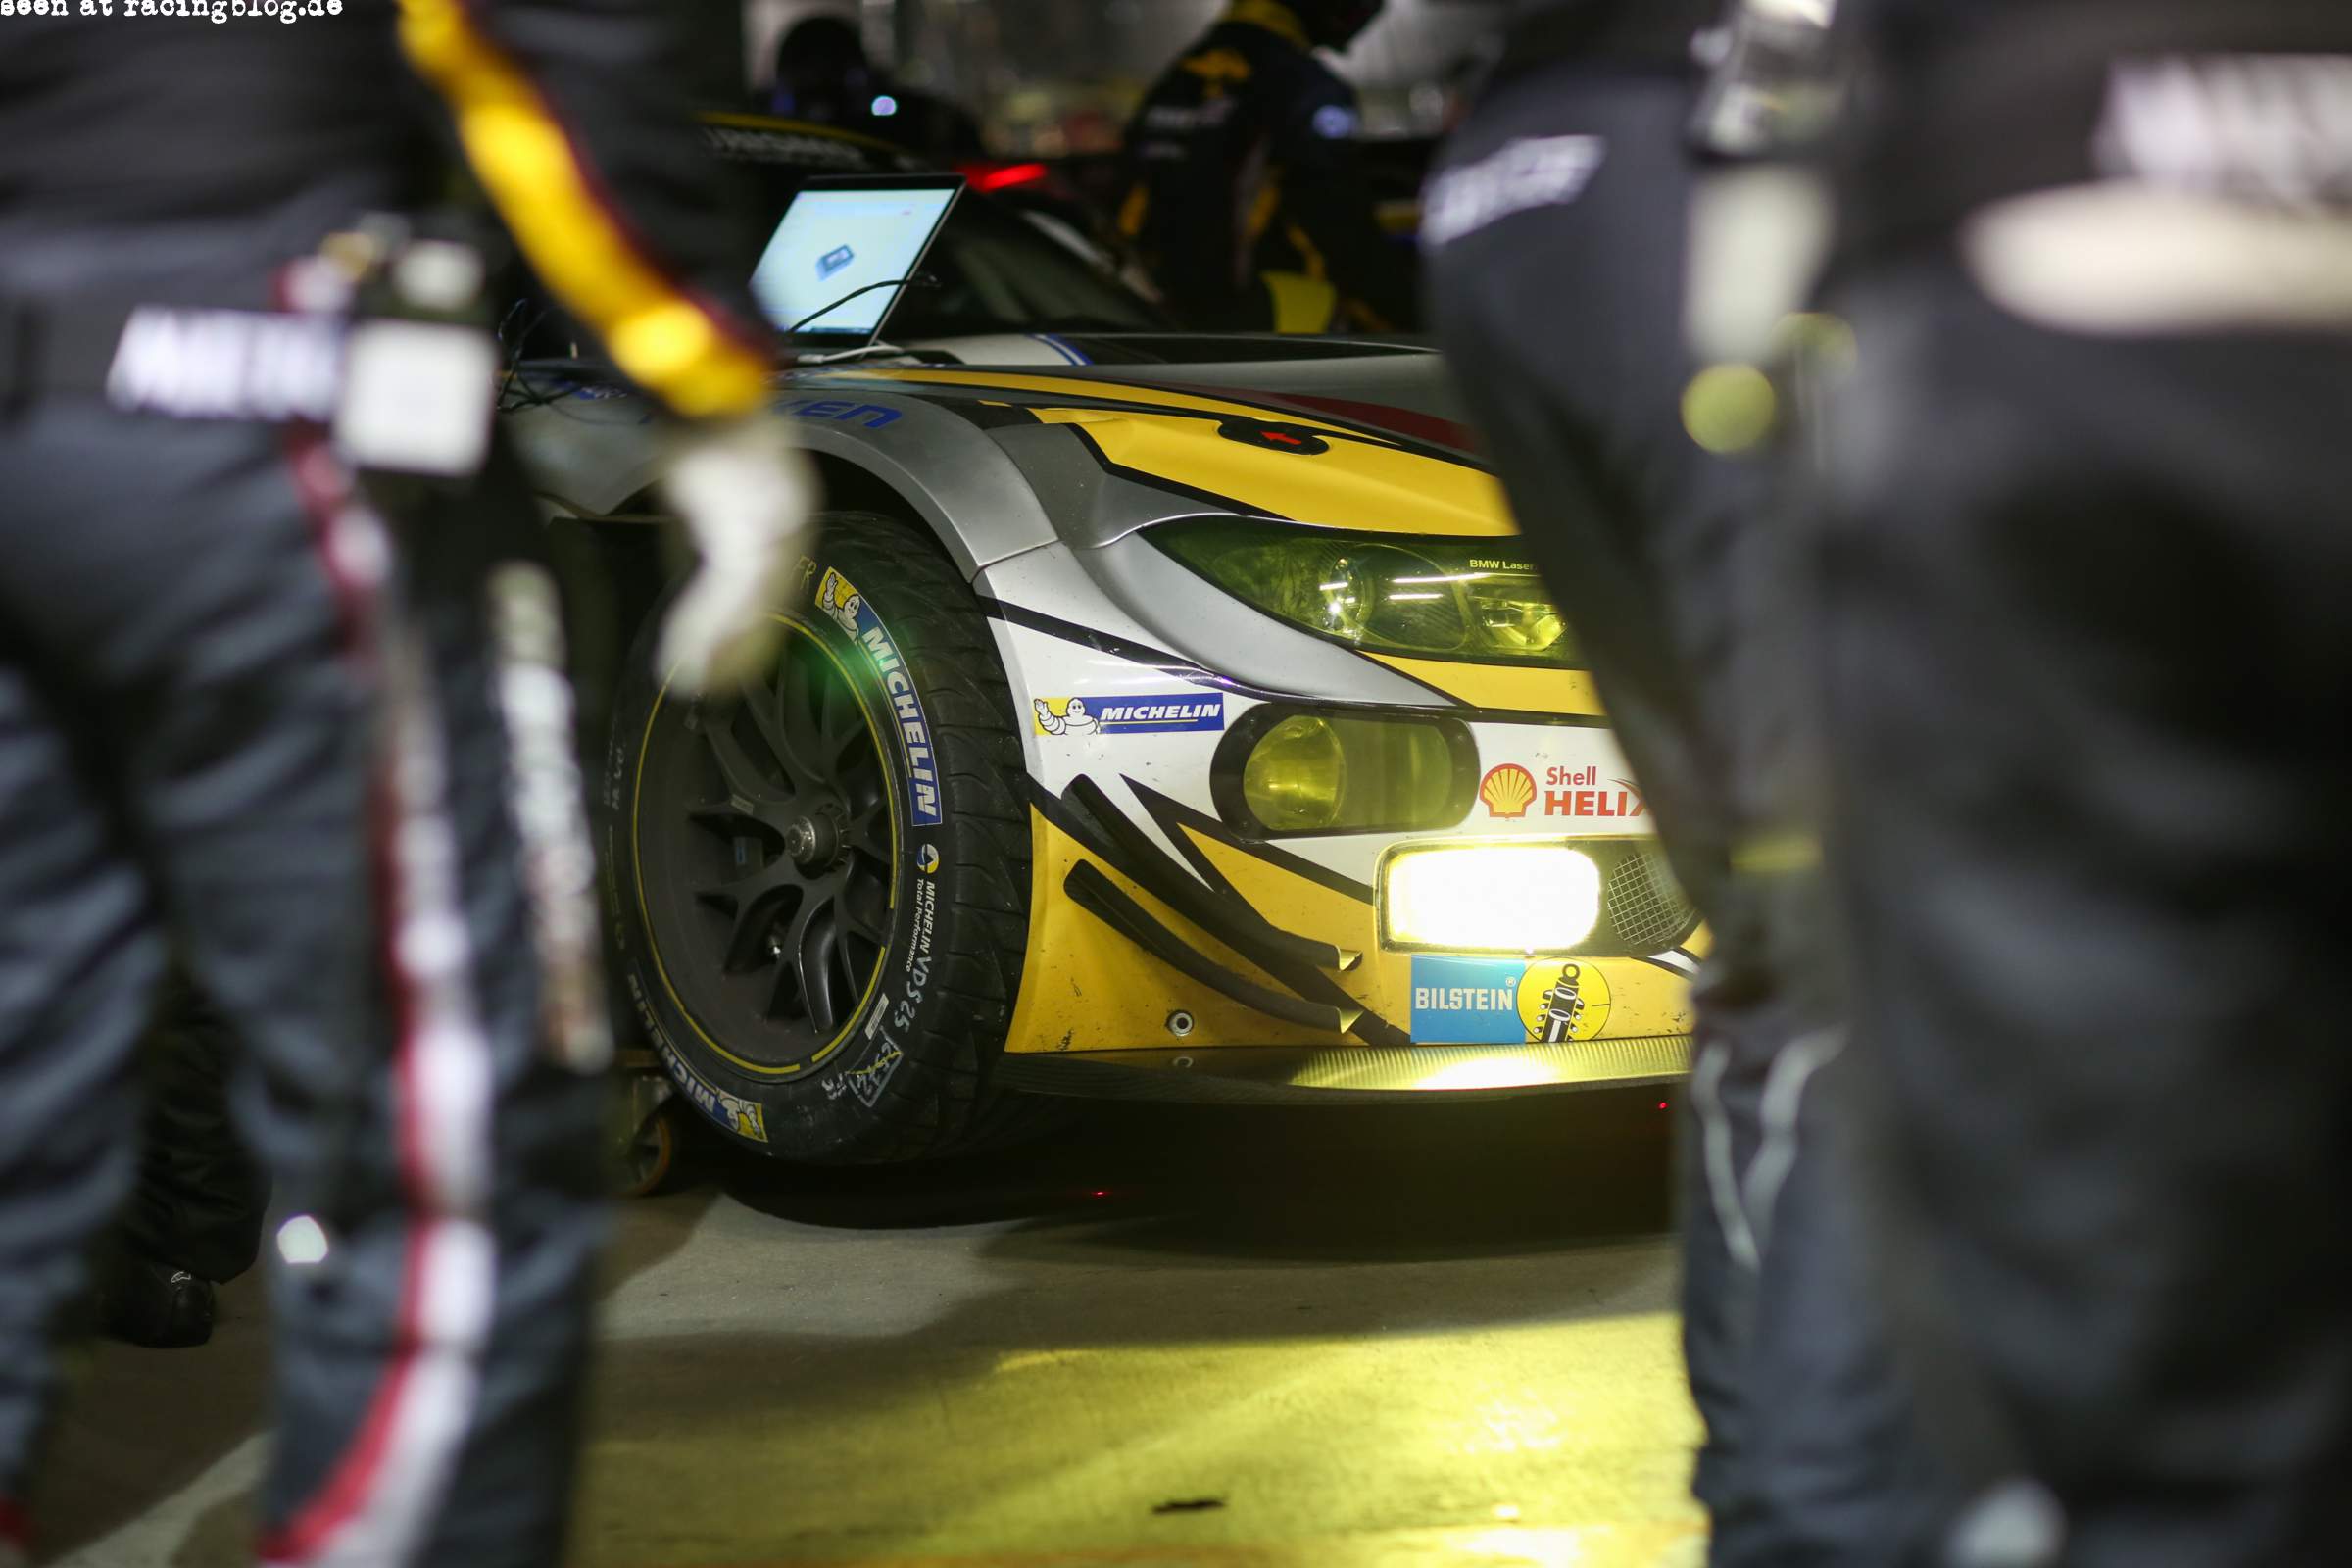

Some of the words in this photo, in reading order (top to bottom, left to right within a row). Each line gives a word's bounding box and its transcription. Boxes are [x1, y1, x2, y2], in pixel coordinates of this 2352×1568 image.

[1469, 559, 1499, 568] BMW
[861, 627, 936, 816] MICHELIN
[1100, 704, 1221, 720] MICHELIN
[1546, 766, 1596, 785] Shell
[915, 879, 924, 906] Total
[919, 881, 935, 954] MICHELIN
[906, 907, 923, 972] Performance
[1415, 987, 1513, 1011] BILSTEIN
